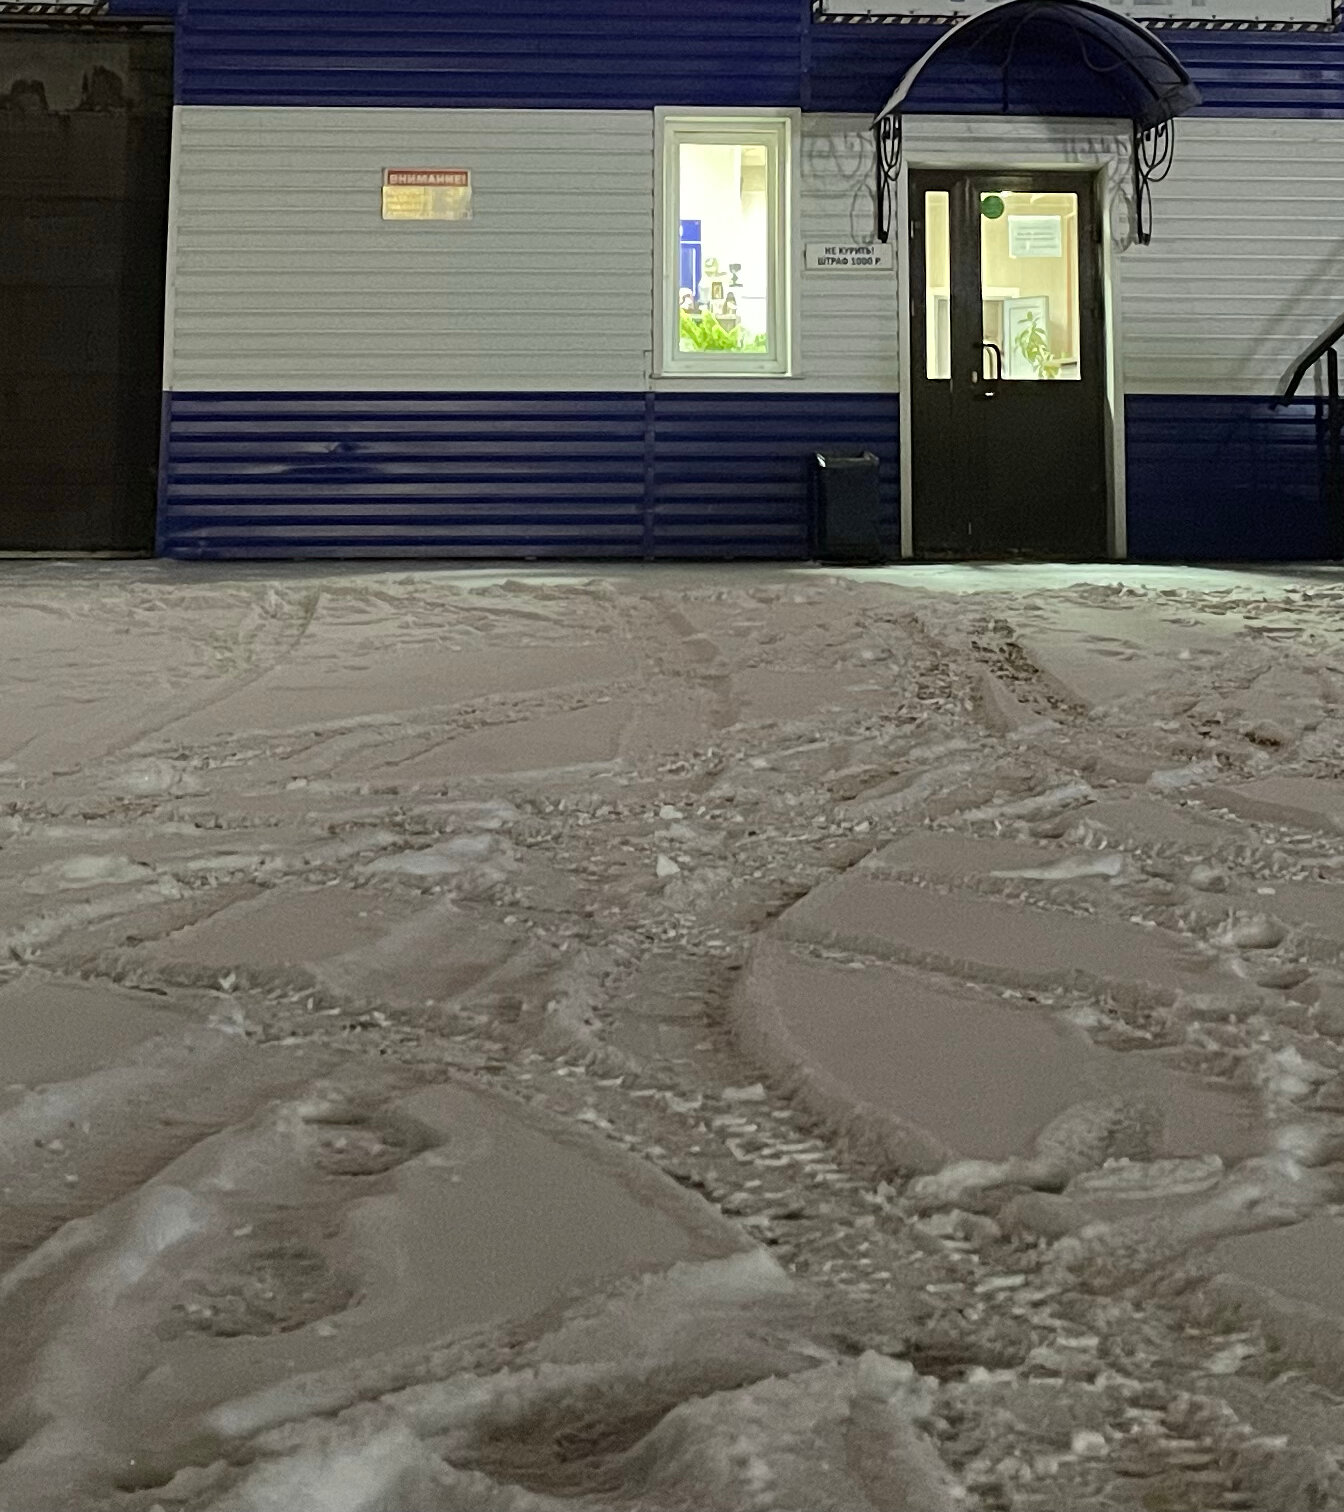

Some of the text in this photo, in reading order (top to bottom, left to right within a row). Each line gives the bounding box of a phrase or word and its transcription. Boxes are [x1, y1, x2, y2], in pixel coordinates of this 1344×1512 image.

[389, 174, 467, 185] ВНИМАНИЕ!
[824, 247, 837, 255] НЕ
[817, 257, 849, 265] ШТРАФ
[851, 257, 873, 265] 1000
